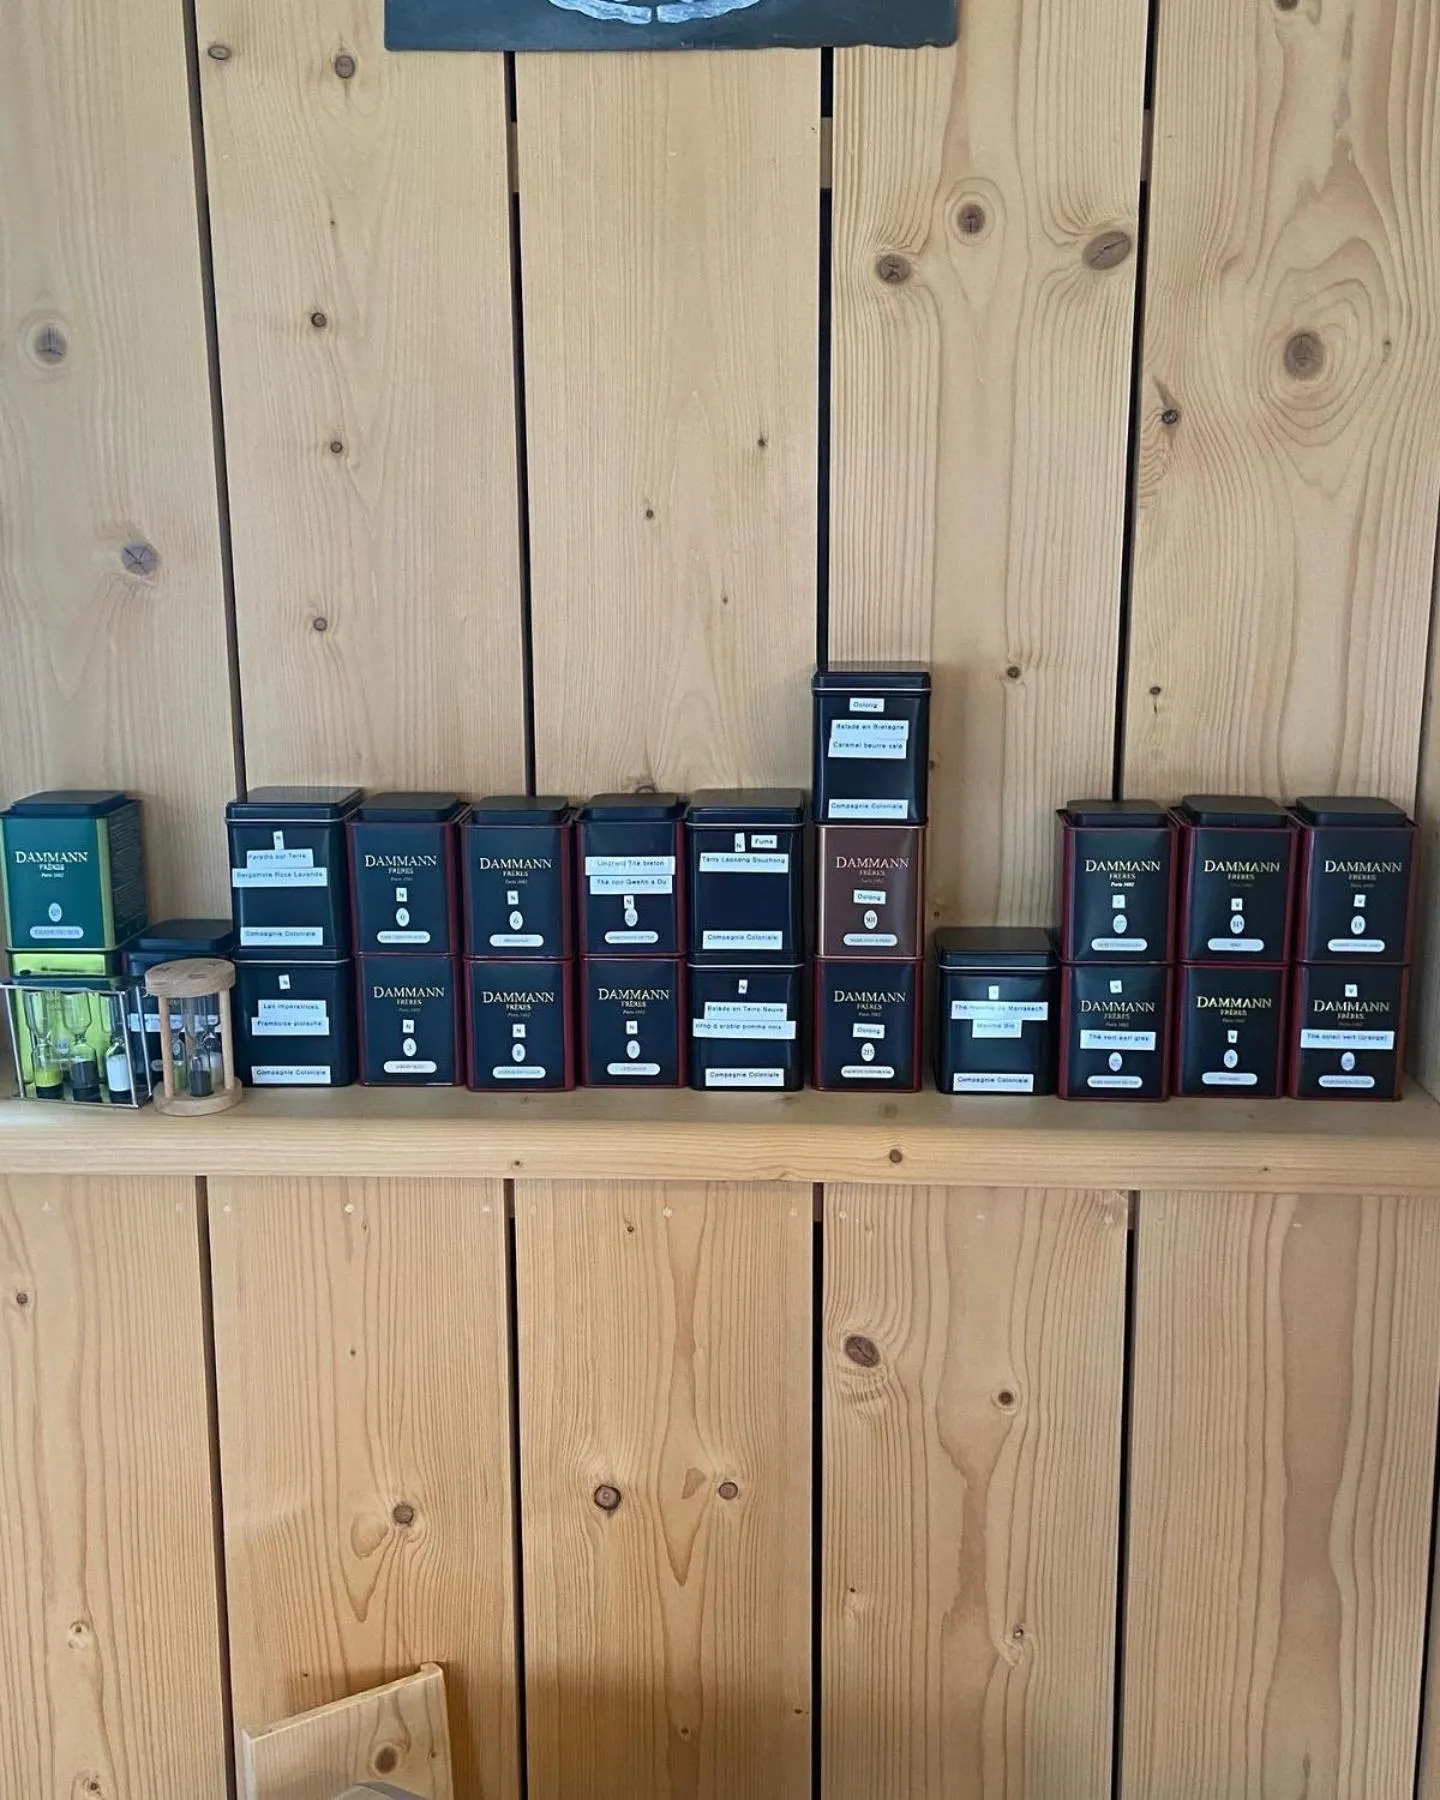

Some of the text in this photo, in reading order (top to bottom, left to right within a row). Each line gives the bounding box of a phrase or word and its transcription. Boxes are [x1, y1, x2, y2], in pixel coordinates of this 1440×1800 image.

[15, 851, 88, 864] DAMMANN
[364, 854, 437, 867] DAMMANN
[479, 857, 552, 870] DAMMANN
[836, 856, 909, 869] DAMMANN
[1085, 859, 1161, 872] DAMMANN
[1204, 859, 1280, 873] DAMMANN
[1325, 860, 1402, 873] DAMMANN
[373, 986, 445, 998] DAMMANN
[482, 991, 555, 1004] DAMMANN
[597, 988, 670, 1001] DAMMANN
[833, 990, 906, 1003] DAMMANN
[1080, 1000, 1155, 1012] DAMMANN
[1196, 995, 1272, 1009] DAMMANN
[1313, 1000, 1390, 1012] DAMMANN
